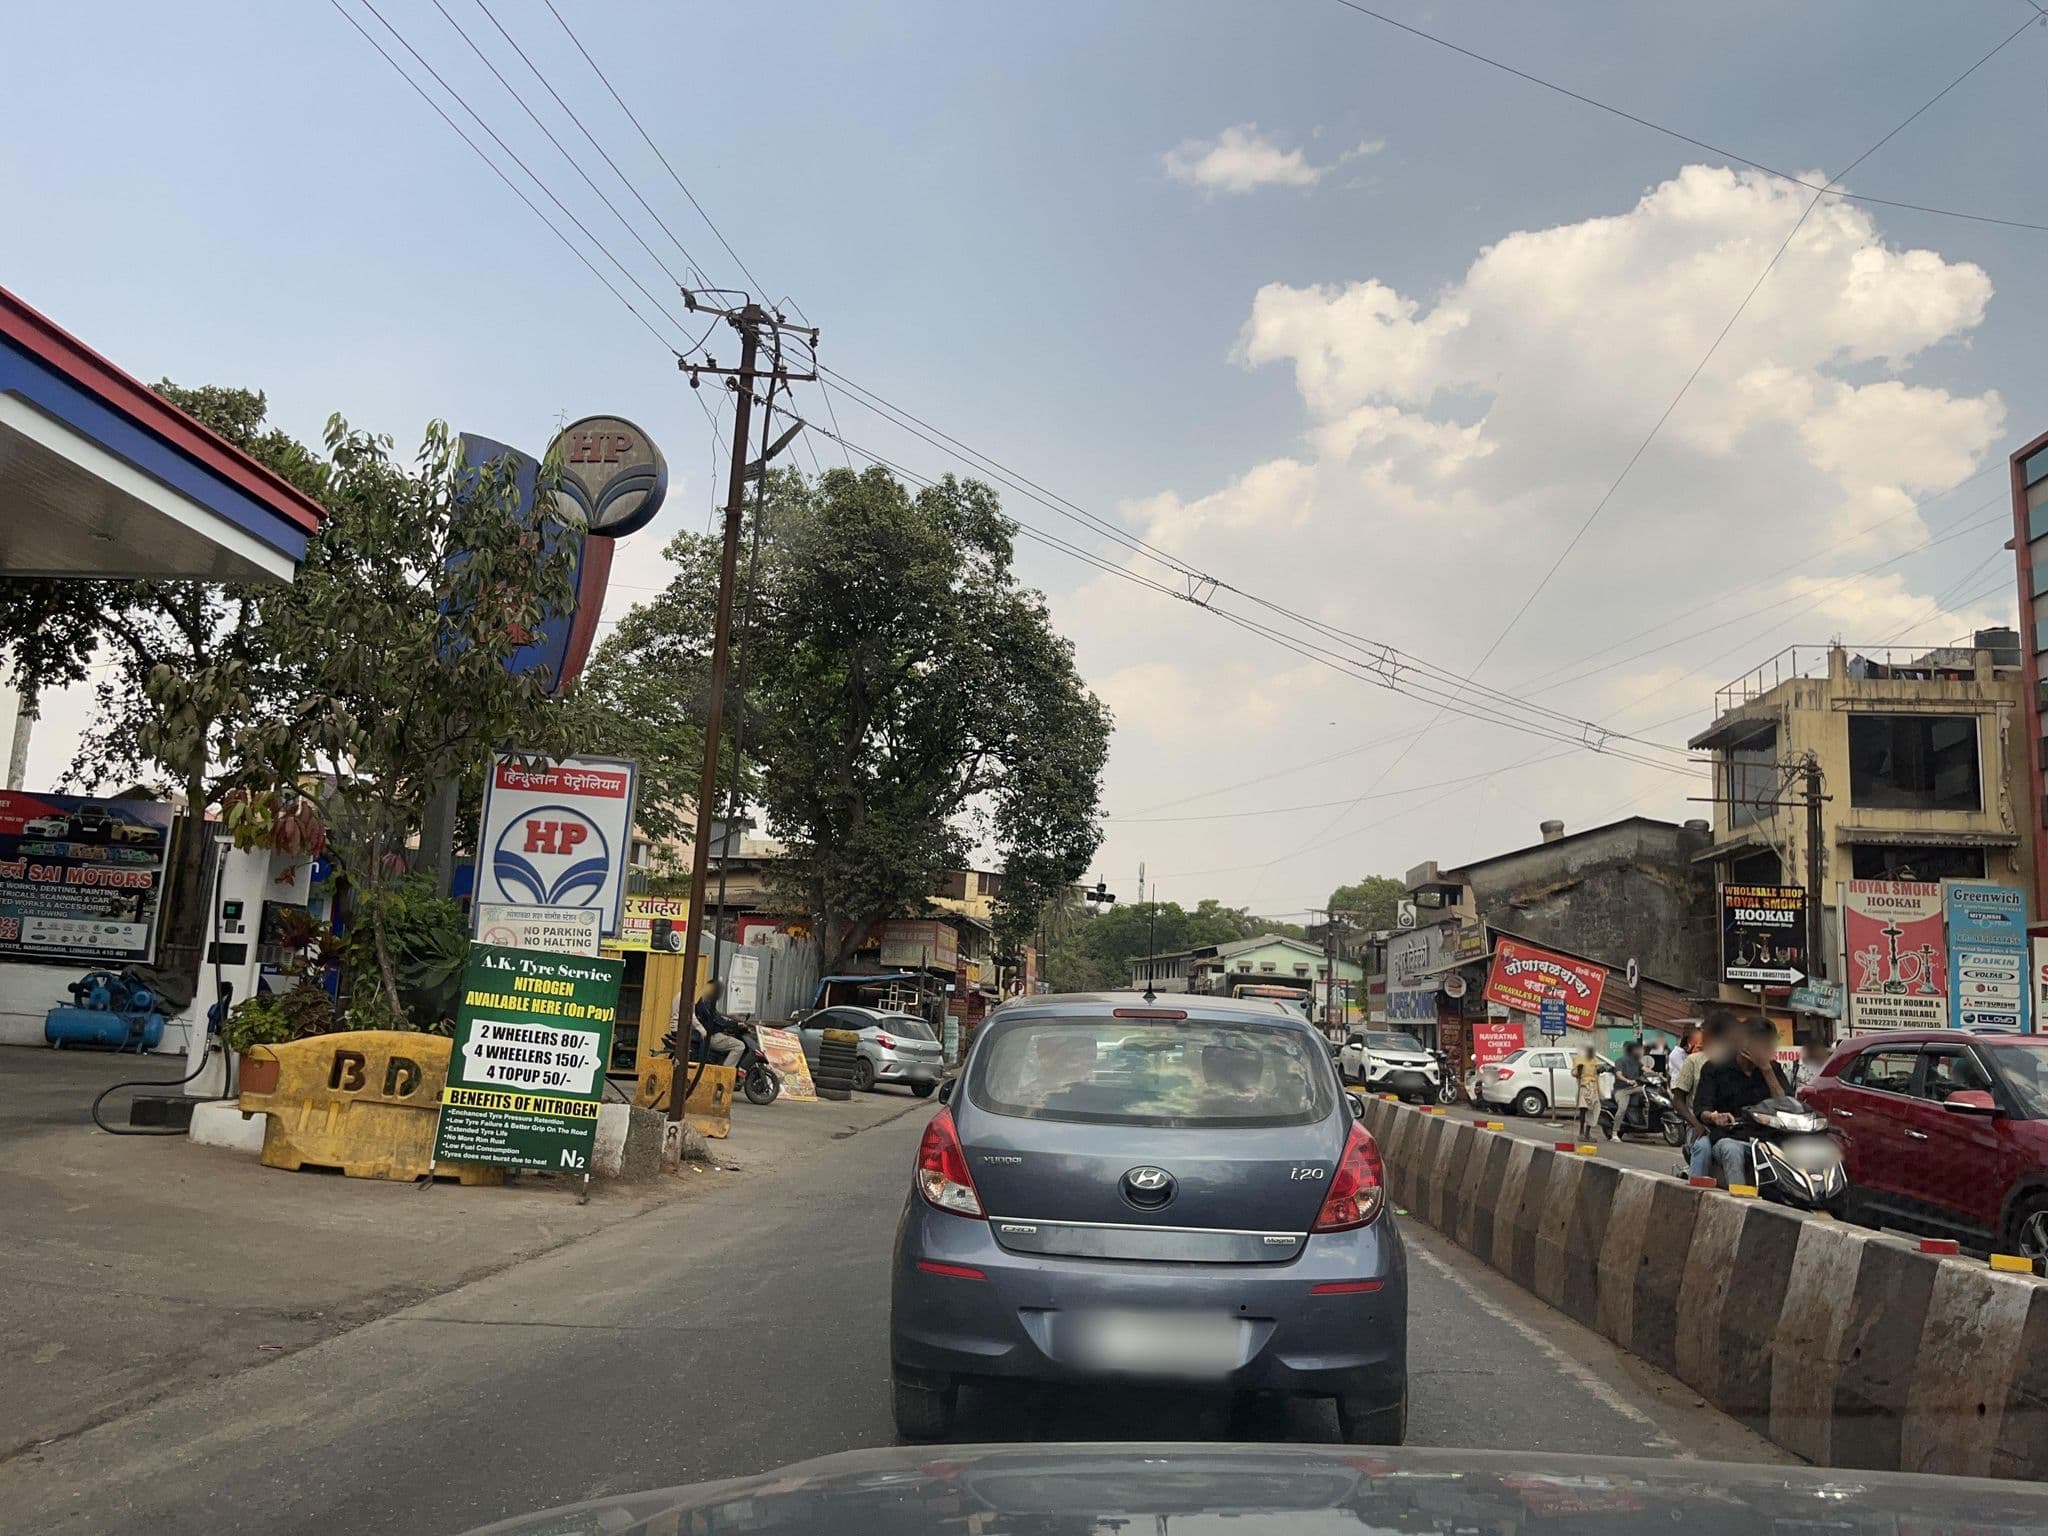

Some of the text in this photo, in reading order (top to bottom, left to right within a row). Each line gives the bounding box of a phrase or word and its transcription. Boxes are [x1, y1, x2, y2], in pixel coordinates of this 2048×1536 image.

[570, 431, 634, 464] HP
[563, 773, 621, 791] पेट्रोलियम
[523, 820, 588, 855] HP
[29, 864, 62, 882] SAI
[66, 867, 153, 888] MOTORS
[1725, 886, 1804, 898] WHOLESALE SHOP
[1849, 880, 1938, 896] ROYAL SMOKE
[1726, 896, 1803, 910] ROYAL SMOKE
[1866, 897, 1921, 908] HOOKAH
[1953, 889, 2020, 904] Greenwich
[15, 899, 46, 908] WORKS
[54, 902, 112, 912] ACCESSORIES
[37, 909, 68, 918] TOWING
[1734, 909, 1794, 922] HOOKAH
[524, 927, 592, 937] NO PARKING
[524, 937, 540, 945] NO
[543, 938, 592, 947] HALTING
[1973, 957, 2015, 966] DAIKIN
[481, 955, 612, 982] A.K. Tyre Service
[513, 976, 574, 997] NITROGEN
[465, 991, 614, 1022] AVAILABLE HERE (On Pay)
[1856, 997, 1868, 1005] ALL
[1869, 997, 1892, 1006] TYPES
[1893, 998, 1901, 1006] OF
[1903, 999, 1934, 1007] HOOKAH
[1861, 1007, 1936, 1018] FLAVOURS AVAILABLE
[1979, 1014, 2015, 1024] LLOYD
[481, 1025, 590, 1049] 2 WHEELERS 80/-
[474, 1044, 589, 1068] 4 WHEELERS 150/-
[487, 1065, 571, 1086] 4 TOPUP 50/-
[451, 1090, 598, 1118] BENEFITS OF NITROGEN
[450, 1117, 464, 1125] Low
[465, 1118, 479, 1126] Tyre
[480, 1120, 502, 1128] Failure
[531, 1124, 545, 1132] Grip
[489, 1112, 502, 1121] Tyre
[504, 1113, 532, 1123] Pressure
[534, 1117, 564, 1125] Retention
[481, 1128, 494, 1136] Tyre
[475, 1136, 489, 1144] Rim
[444, 1150, 462, 1159] Tyres
[463, 1152, 479, 1160] does
[476, 1145, 519, 1155] Consumption
[560, 1149, 585, 1169] N2
[1291, 1168, 1323, 1180] i20
